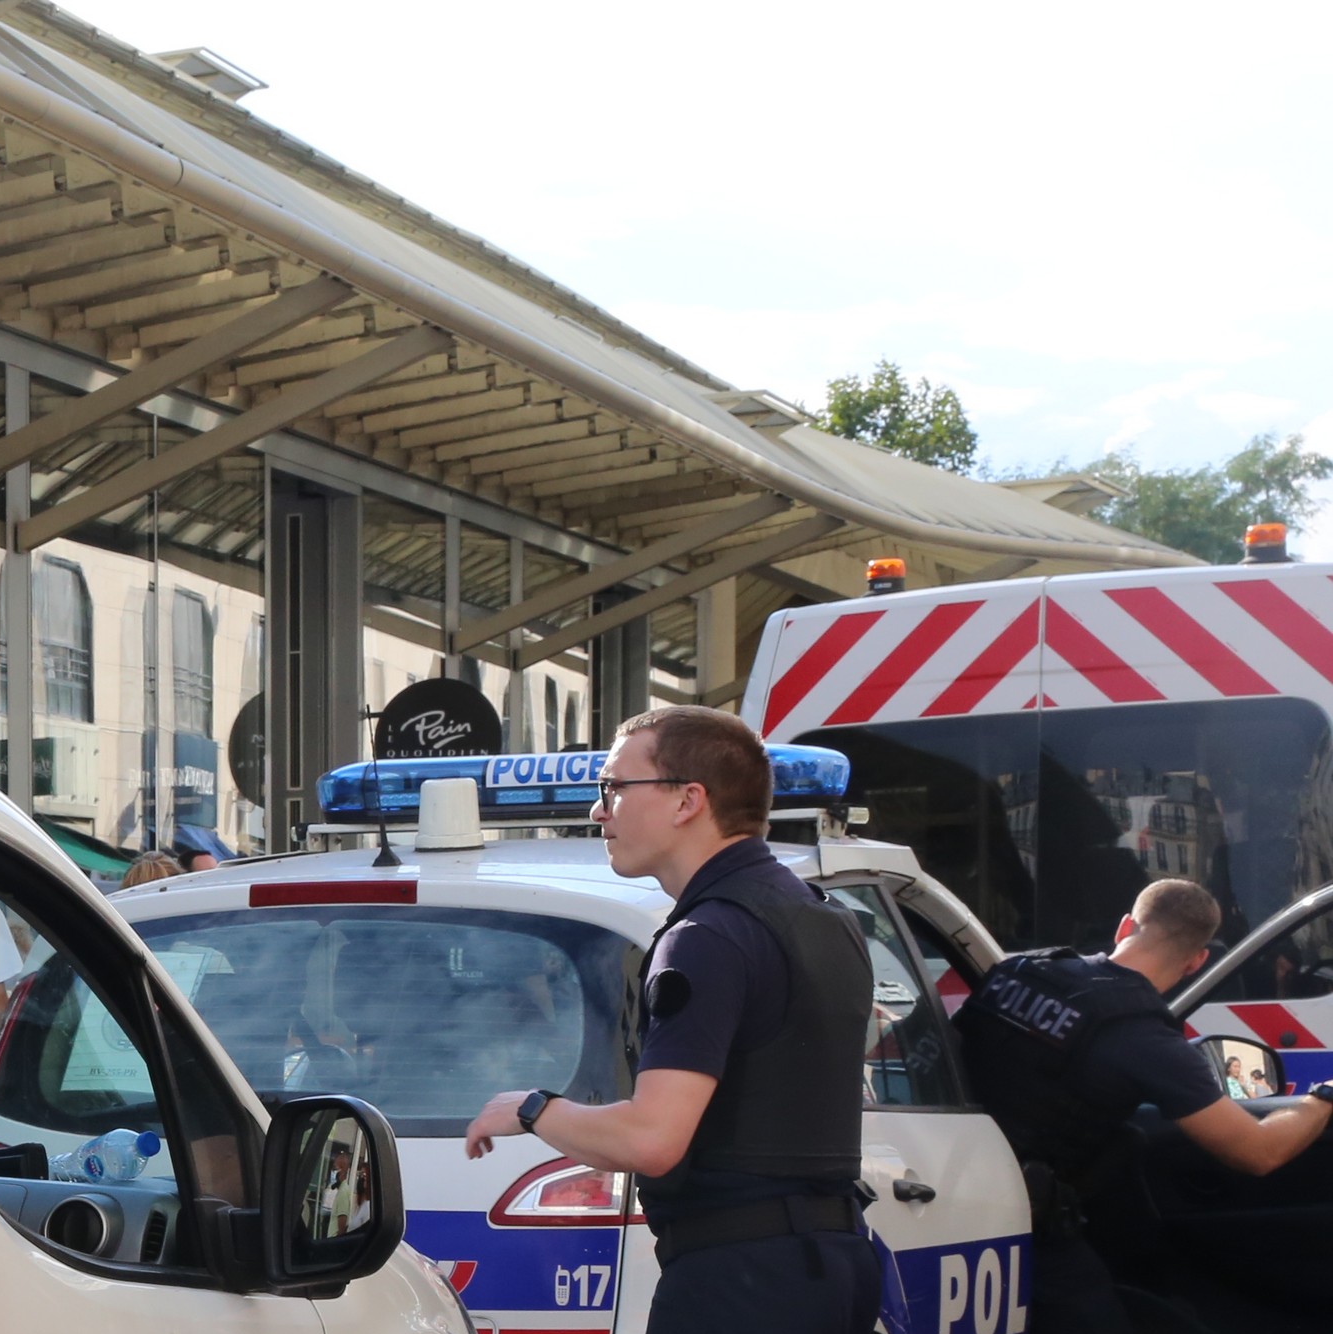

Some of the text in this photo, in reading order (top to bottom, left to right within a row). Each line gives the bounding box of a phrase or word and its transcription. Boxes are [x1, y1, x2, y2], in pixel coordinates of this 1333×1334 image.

[400, 710, 472, 749] Pain
[492, 754, 609, 785] POLICE
[984, 973, 1081, 1041] POLICE
[572, 1265, 611, 1307] 17
